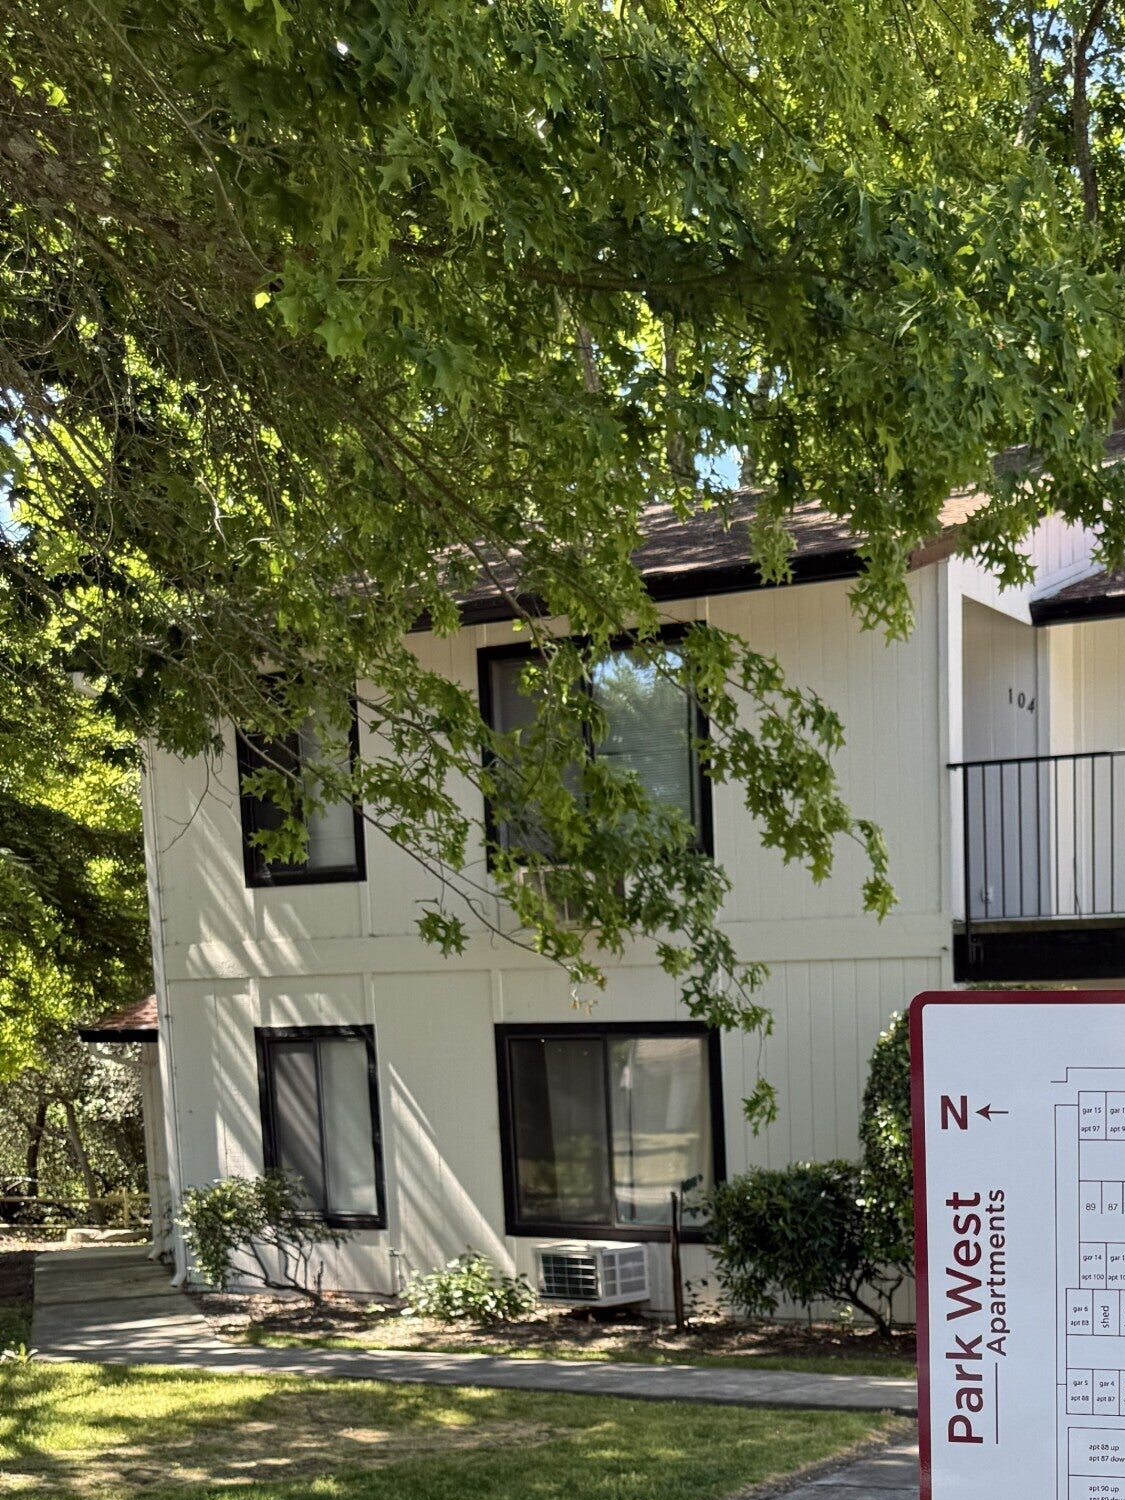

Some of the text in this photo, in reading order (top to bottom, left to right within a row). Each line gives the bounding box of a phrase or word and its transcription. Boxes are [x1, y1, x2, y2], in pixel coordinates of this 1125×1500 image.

[1008, 688, 1036, 715] 104
[940, 1095, 969, 1130] N
[1085, 1203, 1096, 1211] 89
[1108, 1203, 1118, 1211] 87
[986, 1189, 1011, 1357] Apartments
[945, 1191, 984, 1445] Park West
[1101, 1306, 1109, 1328] shed
